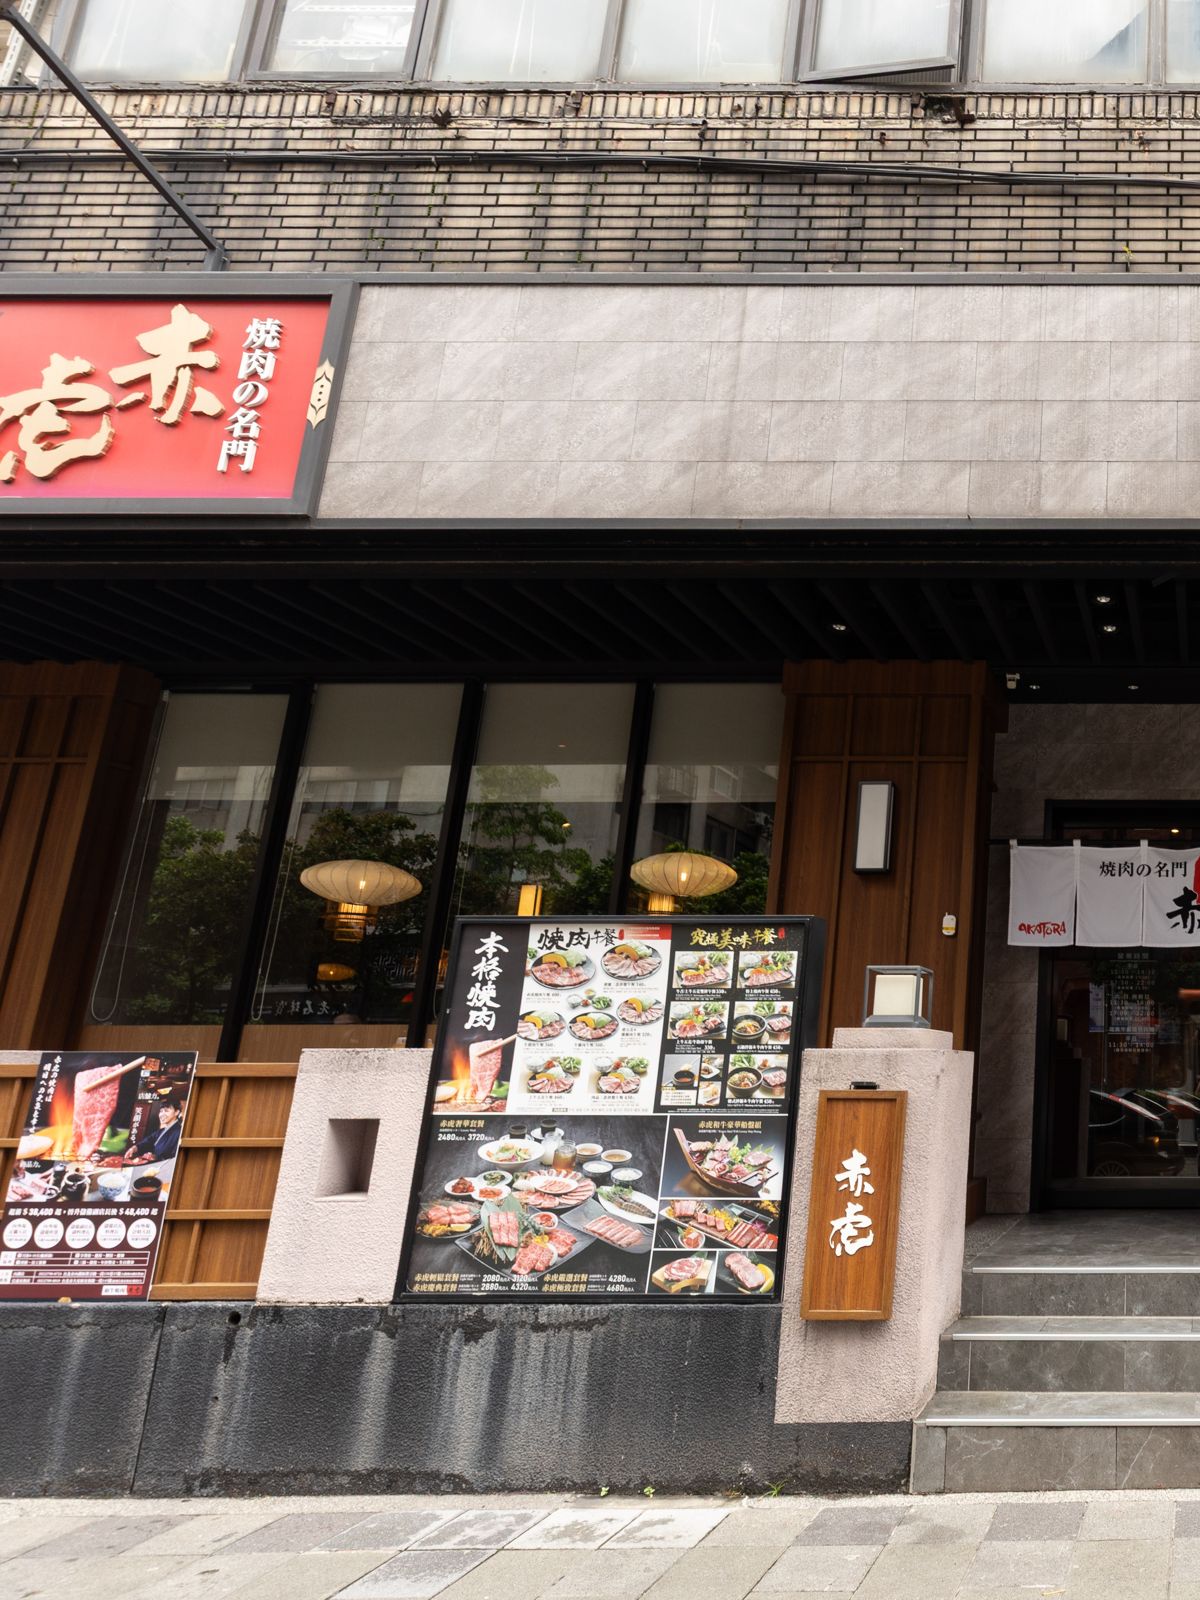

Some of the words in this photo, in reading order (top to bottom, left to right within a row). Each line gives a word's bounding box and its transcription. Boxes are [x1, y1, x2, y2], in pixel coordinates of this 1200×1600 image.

[217, 317, 283, 474] 焼肉の名門
[1099, 861, 1188, 878] 焼肉の名門
[464, 931, 509, 1031] 本格焼肉
